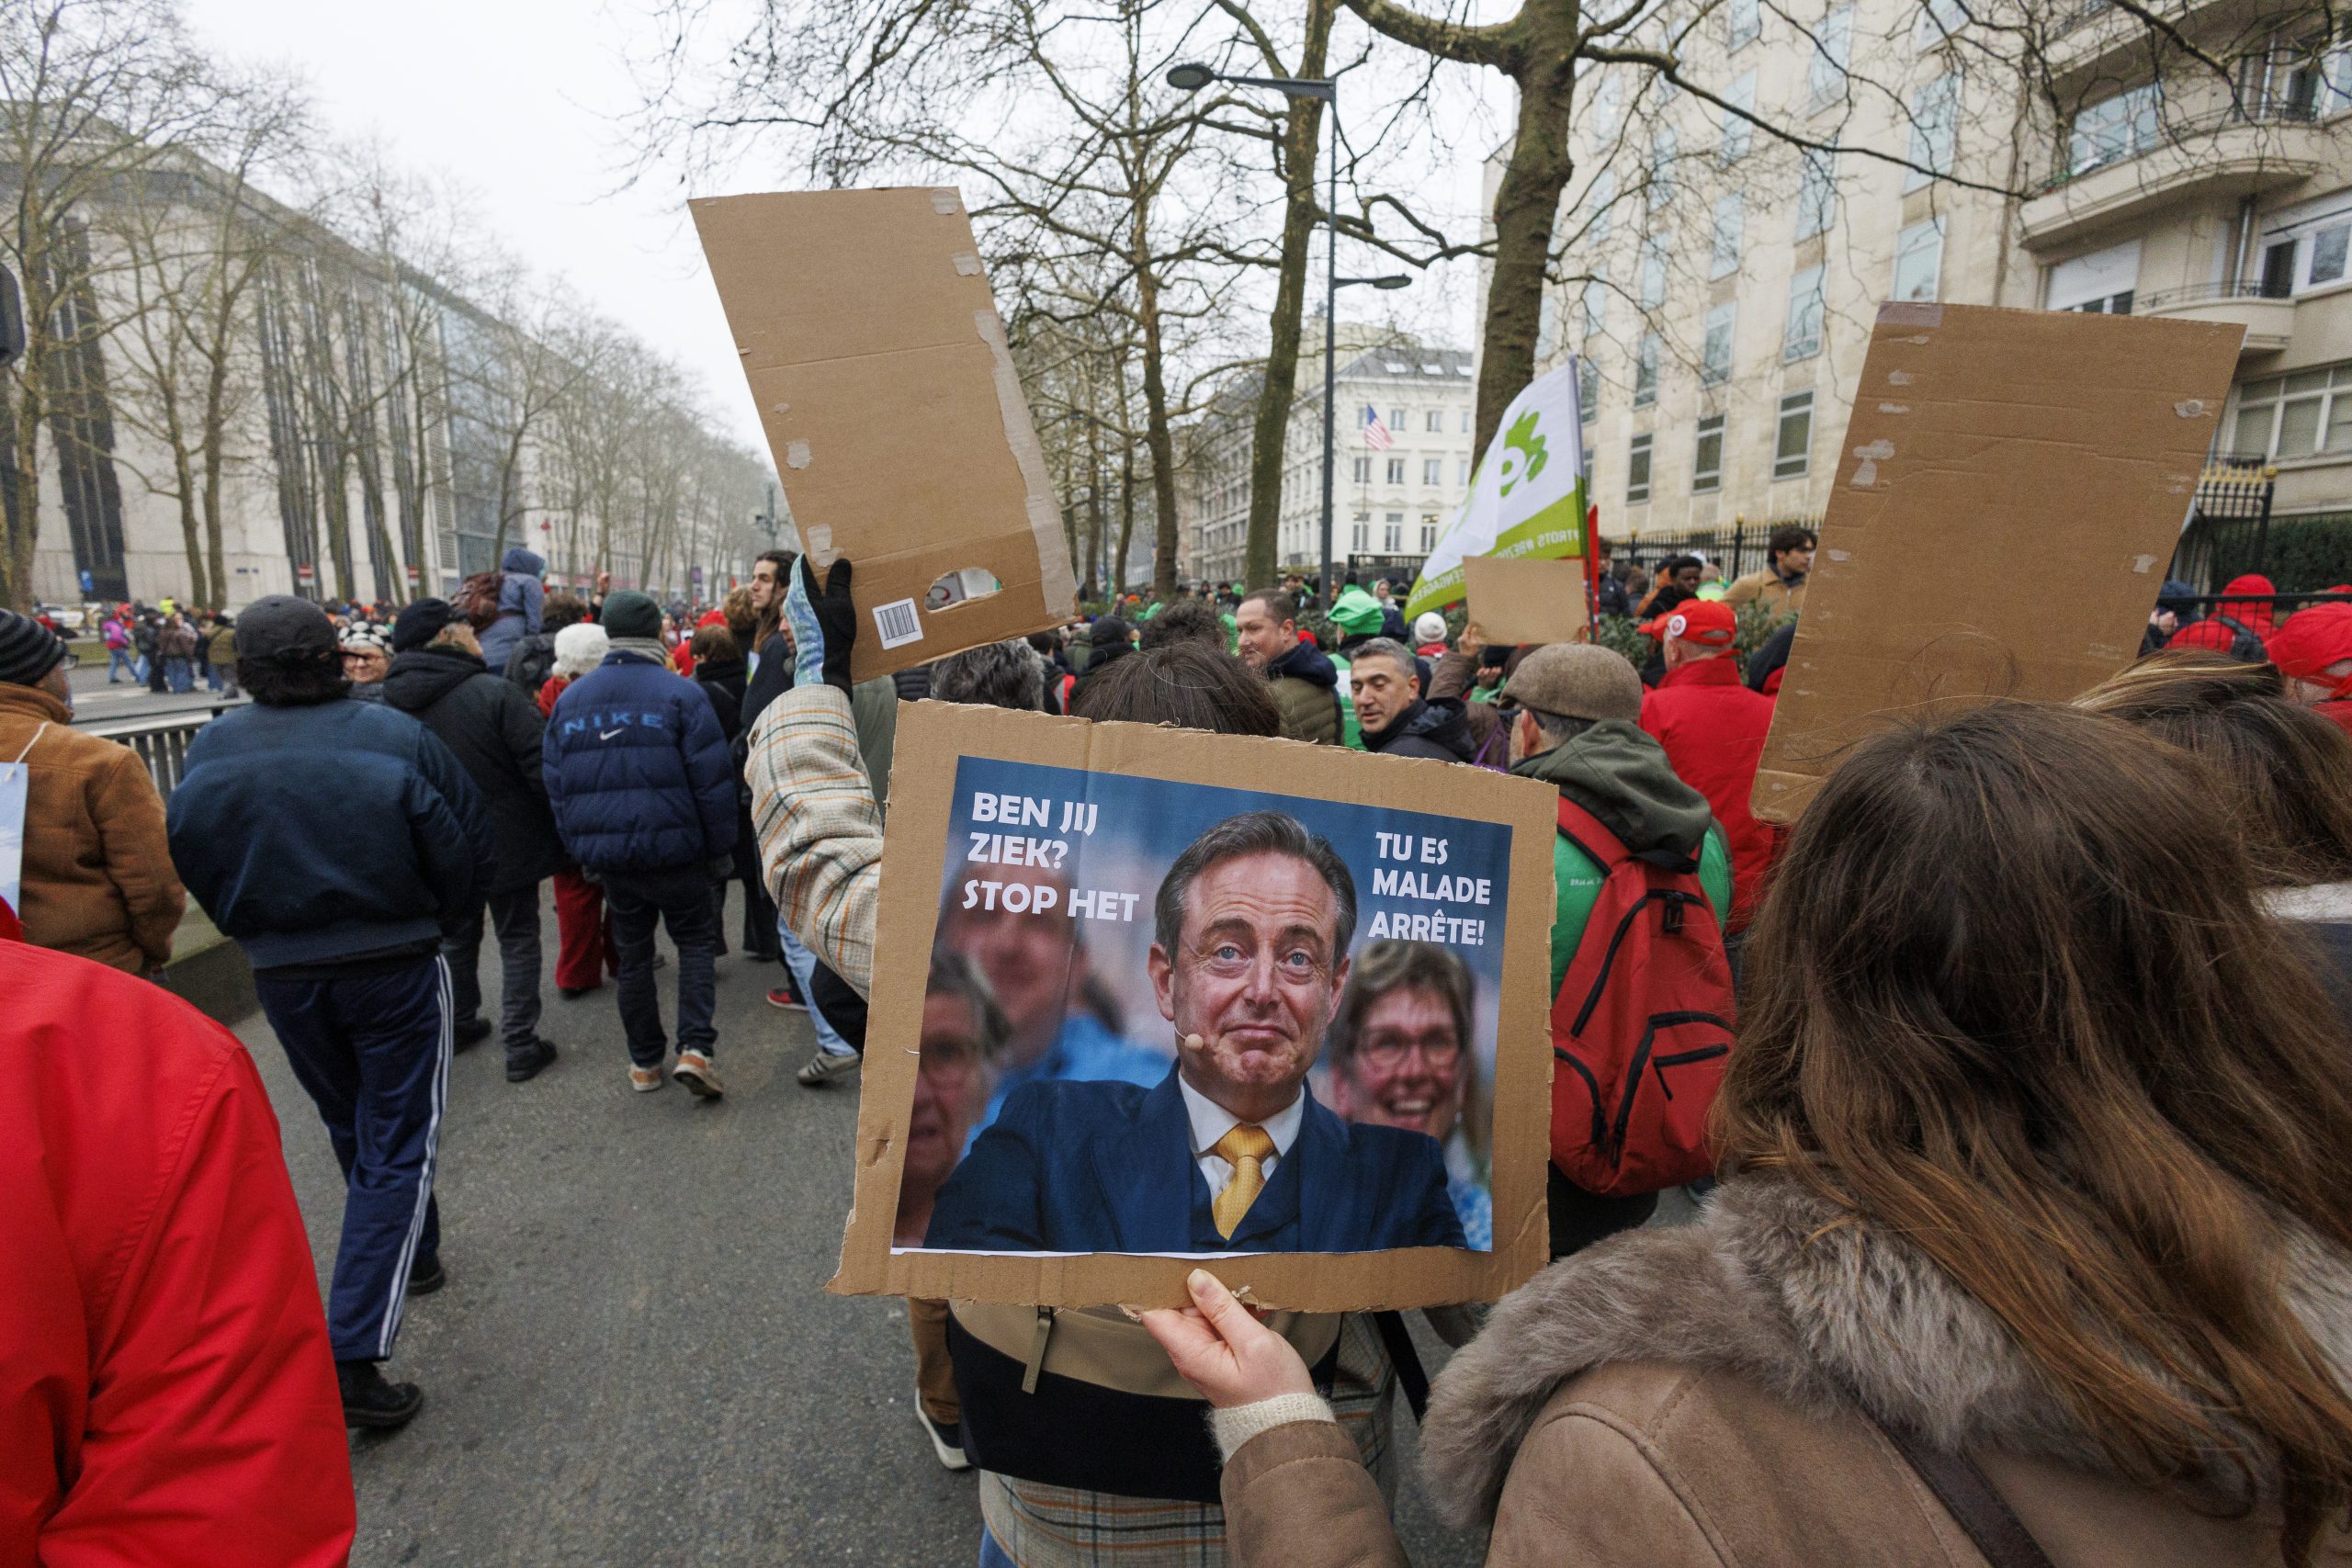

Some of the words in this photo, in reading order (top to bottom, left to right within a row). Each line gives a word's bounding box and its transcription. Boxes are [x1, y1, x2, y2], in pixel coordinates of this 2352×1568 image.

[564, 712, 662, 735] NIKE
[972, 792, 1051, 827] BEN
[1059, 801, 1098, 836] JIJ
[967, 832, 1069, 869] ZIEK?
[1375, 831, 1413, 861] TU
[1420, 837, 1449, 865] ES
[962, 879, 1057, 914] STOP
[1068, 888, 1140, 922] HET
[1372, 868, 1491, 905] MALADE
[1367, 908, 1486, 946] ARRÊTE!
